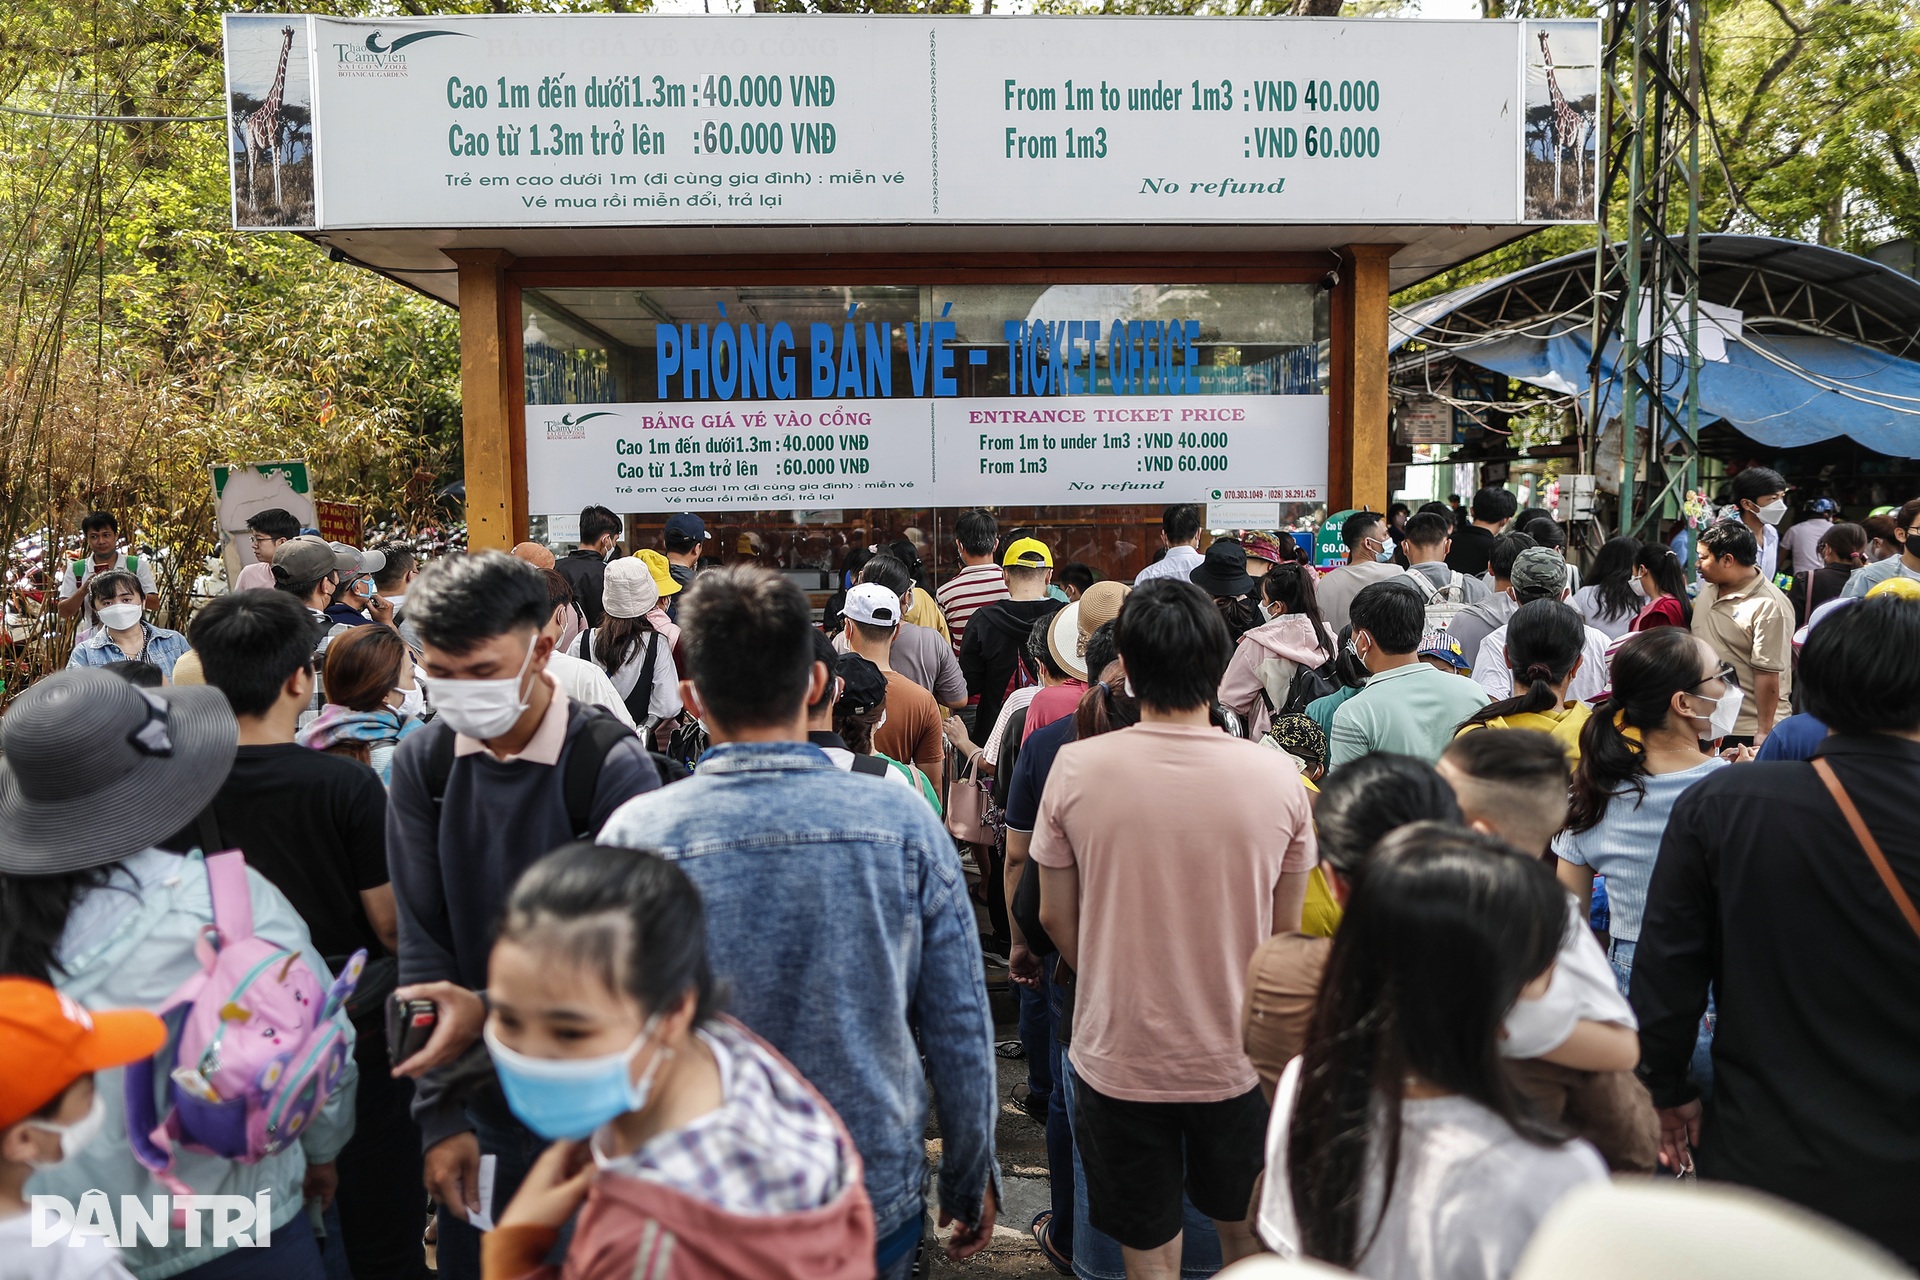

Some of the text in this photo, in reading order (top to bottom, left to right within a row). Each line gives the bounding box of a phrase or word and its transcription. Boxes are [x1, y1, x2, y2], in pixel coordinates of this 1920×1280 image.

[447, 76, 488, 109] Cao
[498, 77, 529, 108] 1m
[538, 73, 576, 108] đến
[790, 76, 835, 106] VNĐ
[1005, 80, 1055, 111] From
[1065, 80, 1093, 110] 1m
[1100, 81, 1120, 111] to
[1128, 80, 1182, 111] under
[1192, 80, 1232, 111] 1m3
[1305, 80, 1379, 111] 40.000
[449, 124, 490, 156] Cao
[497, 124, 521, 156] từ
[530, 124, 583, 155] 1.3m
[591, 120, 624, 155] trở
[633, 123, 664, 155] lên
[791, 123, 836, 154] VNĐ
[1006, 128, 1056, 158] From
[1066, 127, 1107, 158] 1m3
[1305, 125, 1379, 158] 60.000
[445, 172, 472, 186] Trẻ
[480, 177, 509, 186] em
[516, 177, 553, 185] cao
[560, 173, 601, 185] dưới
[611, 174, 636, 184] 1m
[644, 173, 667, 186] (đi
[674, 172, 722, 187] cùng
[729, 173, 758, 187] gia
[765, 172, 811, 185] đình)
[830, 169, 875, 183] miễn
[882, 172, 904, 183] vé
[1139, 178, 1285, 197] No refund
[522, 191, 781, 207] Vé mua rồi miễn đổi, trả lại
[656, 301, 796, 400] PHÒNG
[810, 302, 892, 398] BÁN
[905, 302, 957, 397] VÉ
[1004, 319, 1100, 396] TICKET
[1109, 318, 1199, 396] OFFICE
[642, 405, 871, 429] BẢNG GIÁ VÉ VÀO CỔNG
[969, 409, 1245, 423] ENTRANCE TICKET PRICE
[617, 439, 642, 455] Cao
[649, 439, 670, 454] 1m
[675, 436, 700, 453] đến
[839, 435, 868, 450] VNĐ
[980, 435, 1013, 450] From
[1020, 434, 1038, 449] 1m
[1043, 435, 1056, 449] to
[1061, 434, 1097, 449] under
[1103, 433, 1130, 448] 1m3
[1178, 432, 1228, 448] 40.000
[618, 462, 643, 478] Cao
[648, 462, 664, 478] từ
[670, 461, 704, 477] 1.3m
[709, 459, 731, 476] trở
[737, 460, 757, 476] lên
[840, 458, 869, 474] VNĐ
[981, 458, 1013, 473] From
[1020, 457, 1047, 473] 1m3
[1179, 455, 1227, 471] 60.000
[1068, 481, 1164, 491] No refund
[1225, 490, 1263, 499] 070.303.1049
[1269, 490, 1283, 499] (028)
[1285, 490, 1316, 498] 38.291.425
[1325, 521, 1336, 531] Cao
